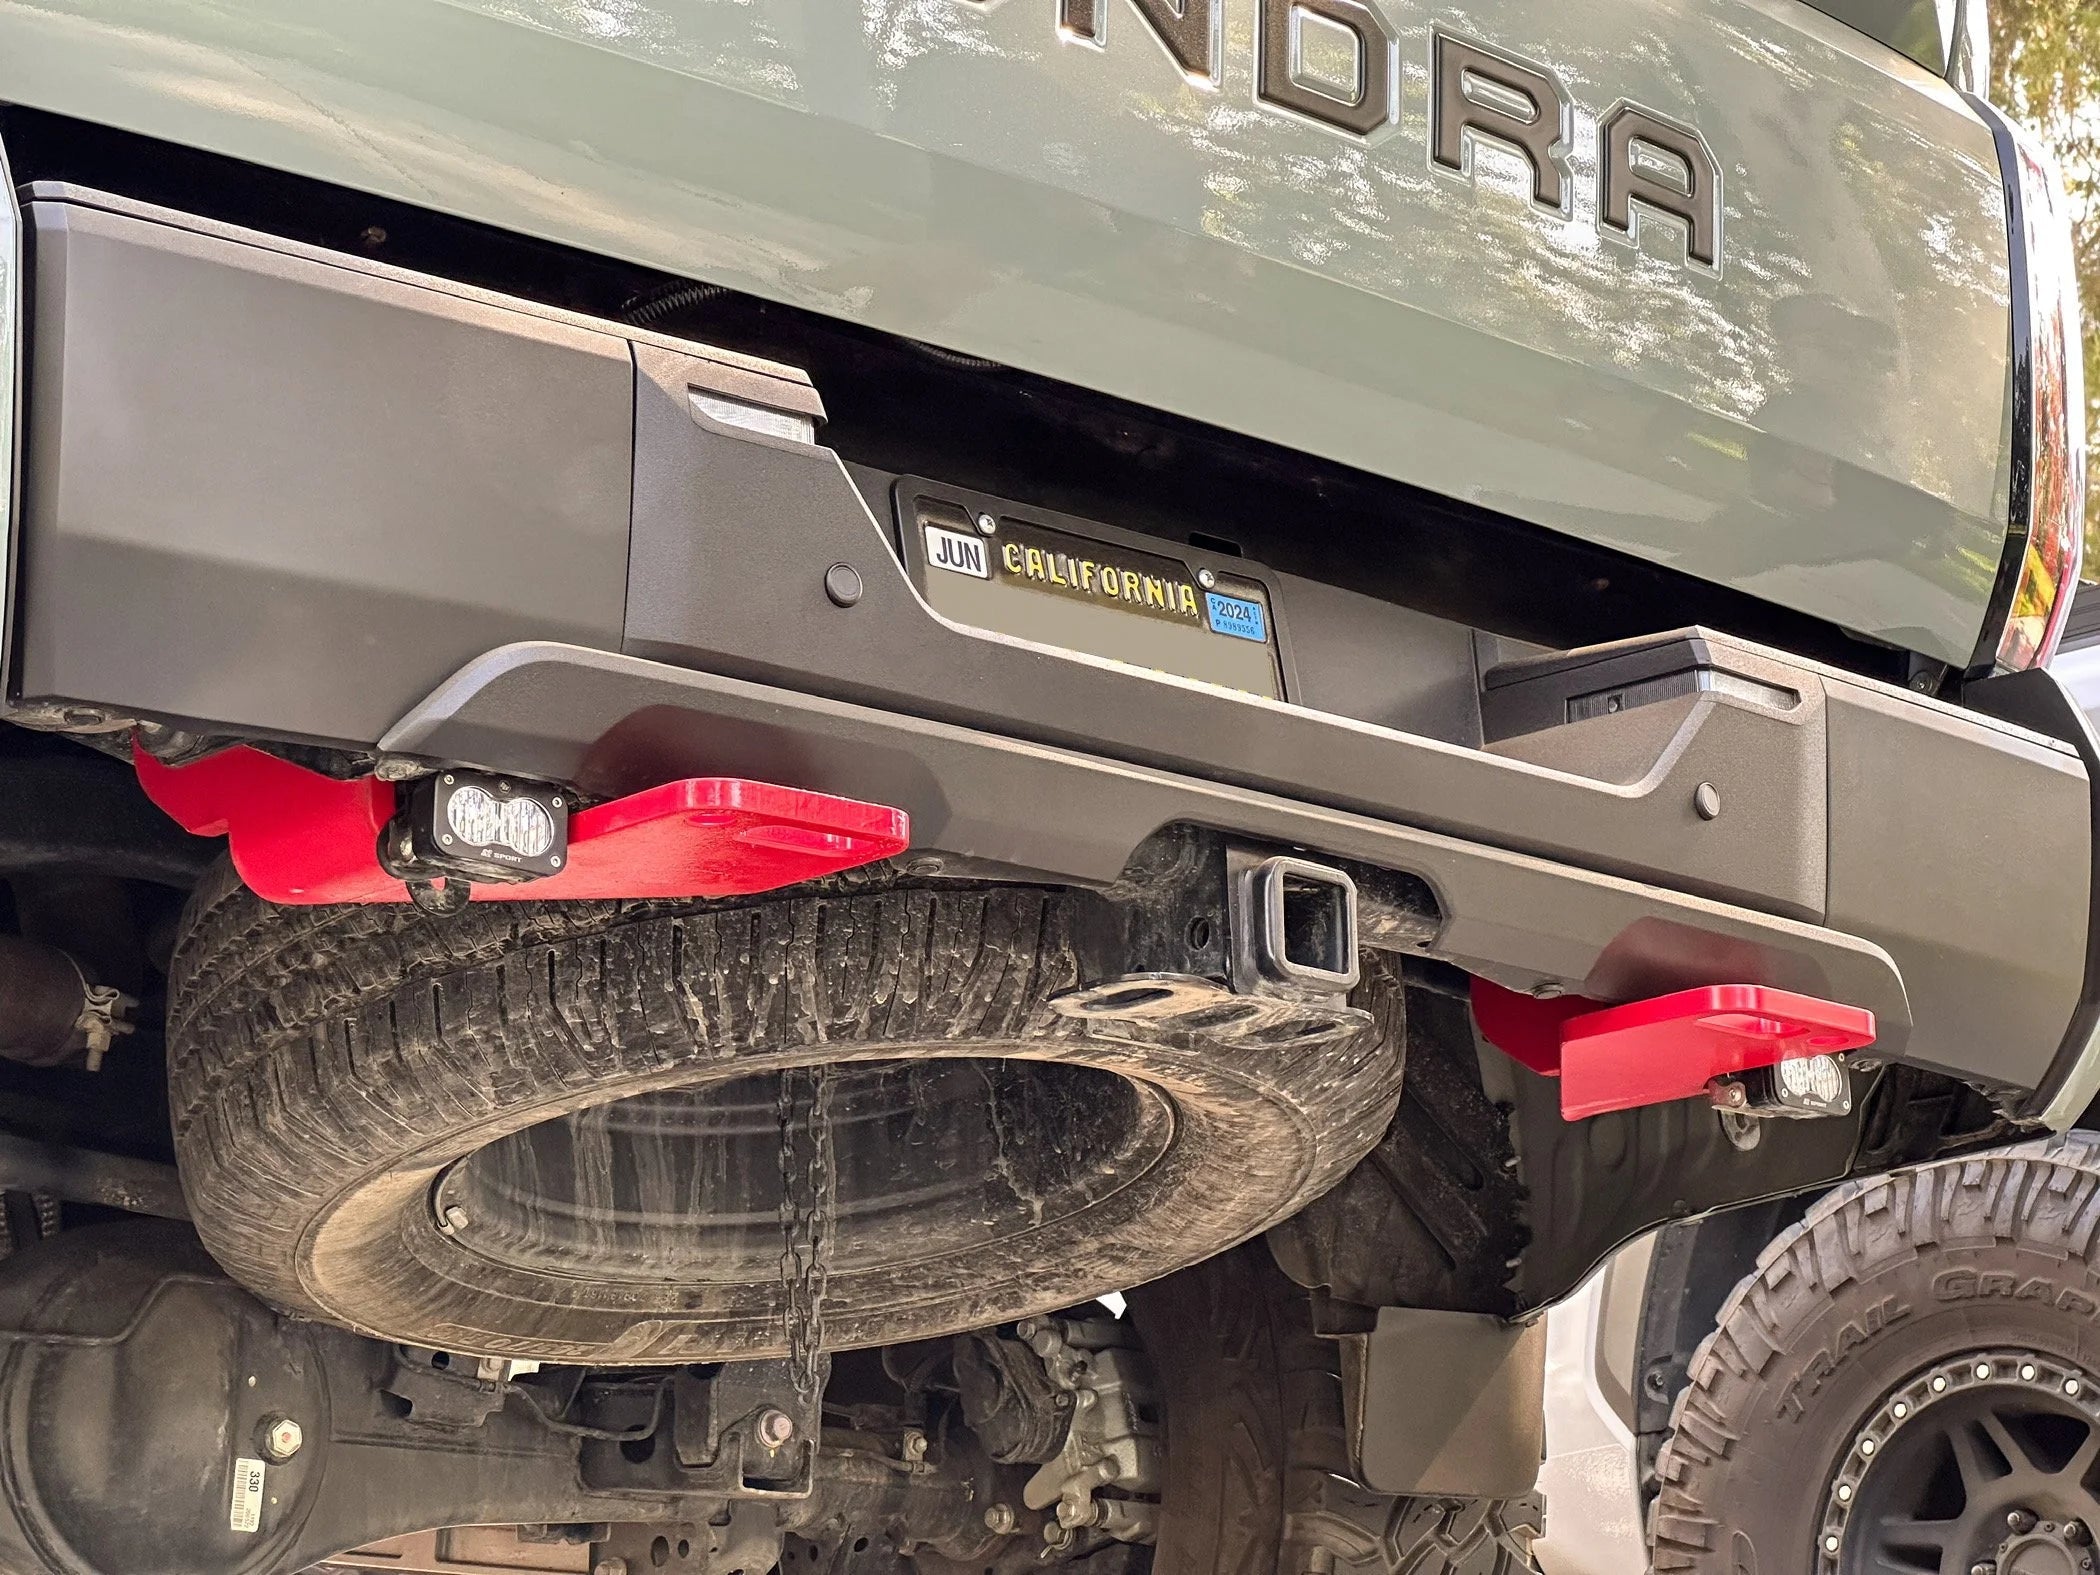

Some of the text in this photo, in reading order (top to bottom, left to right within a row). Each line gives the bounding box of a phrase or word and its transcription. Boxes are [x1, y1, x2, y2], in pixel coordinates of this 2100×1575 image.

[948, 0, 1722, 281] NDRA
[935, 536, 983, 574] JUN
[1002, 543, 1199, 618] CALIFORNIA
[1217, 600, 1252, 622] 2024
[493, 851, 523, 863] SPORT
[1774, 1268, 2100, 1424] TRAIL GRAP
[248, 1470, 261, 1493] 330
